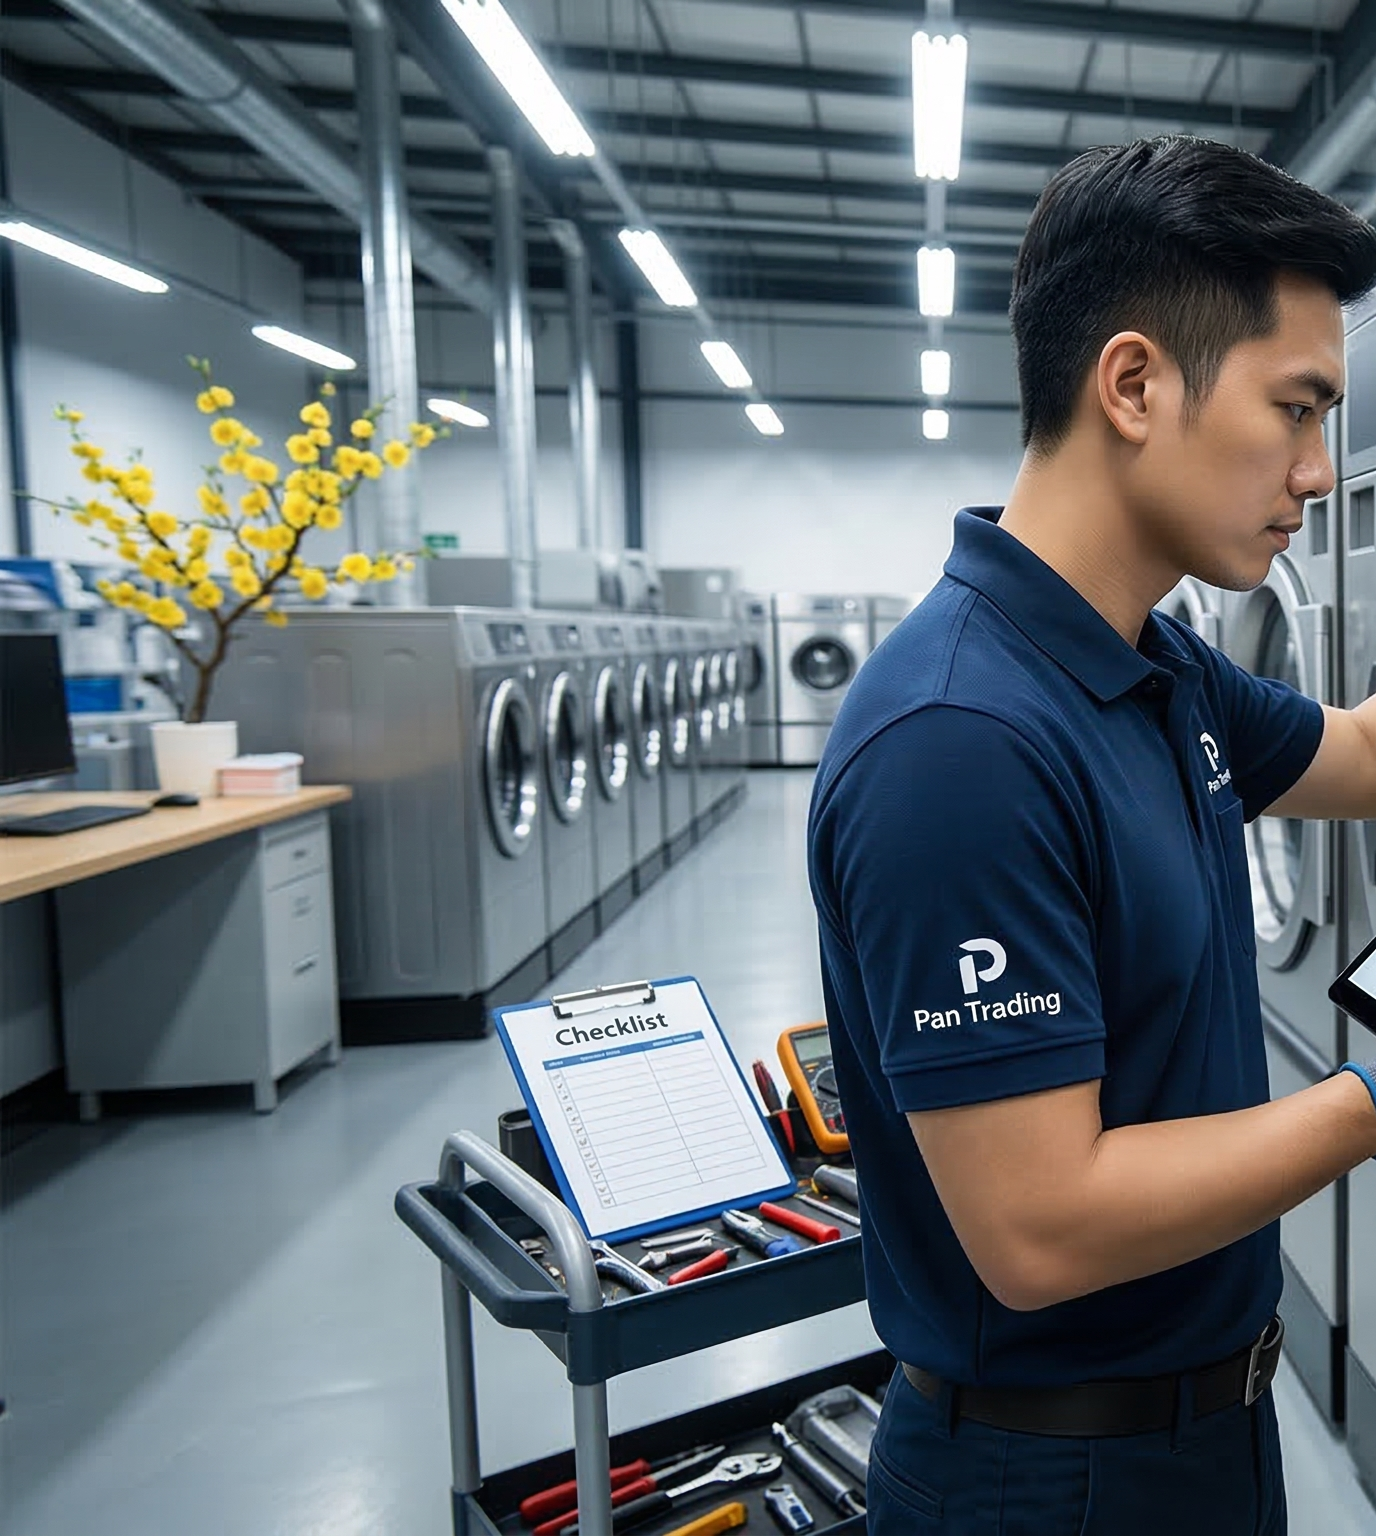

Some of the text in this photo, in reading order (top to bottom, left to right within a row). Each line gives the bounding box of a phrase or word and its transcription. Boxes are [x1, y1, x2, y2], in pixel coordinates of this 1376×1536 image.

[555, 1012, 669, 1046] Checklist
[914, 992, 1061, 1032] Pan Trading
